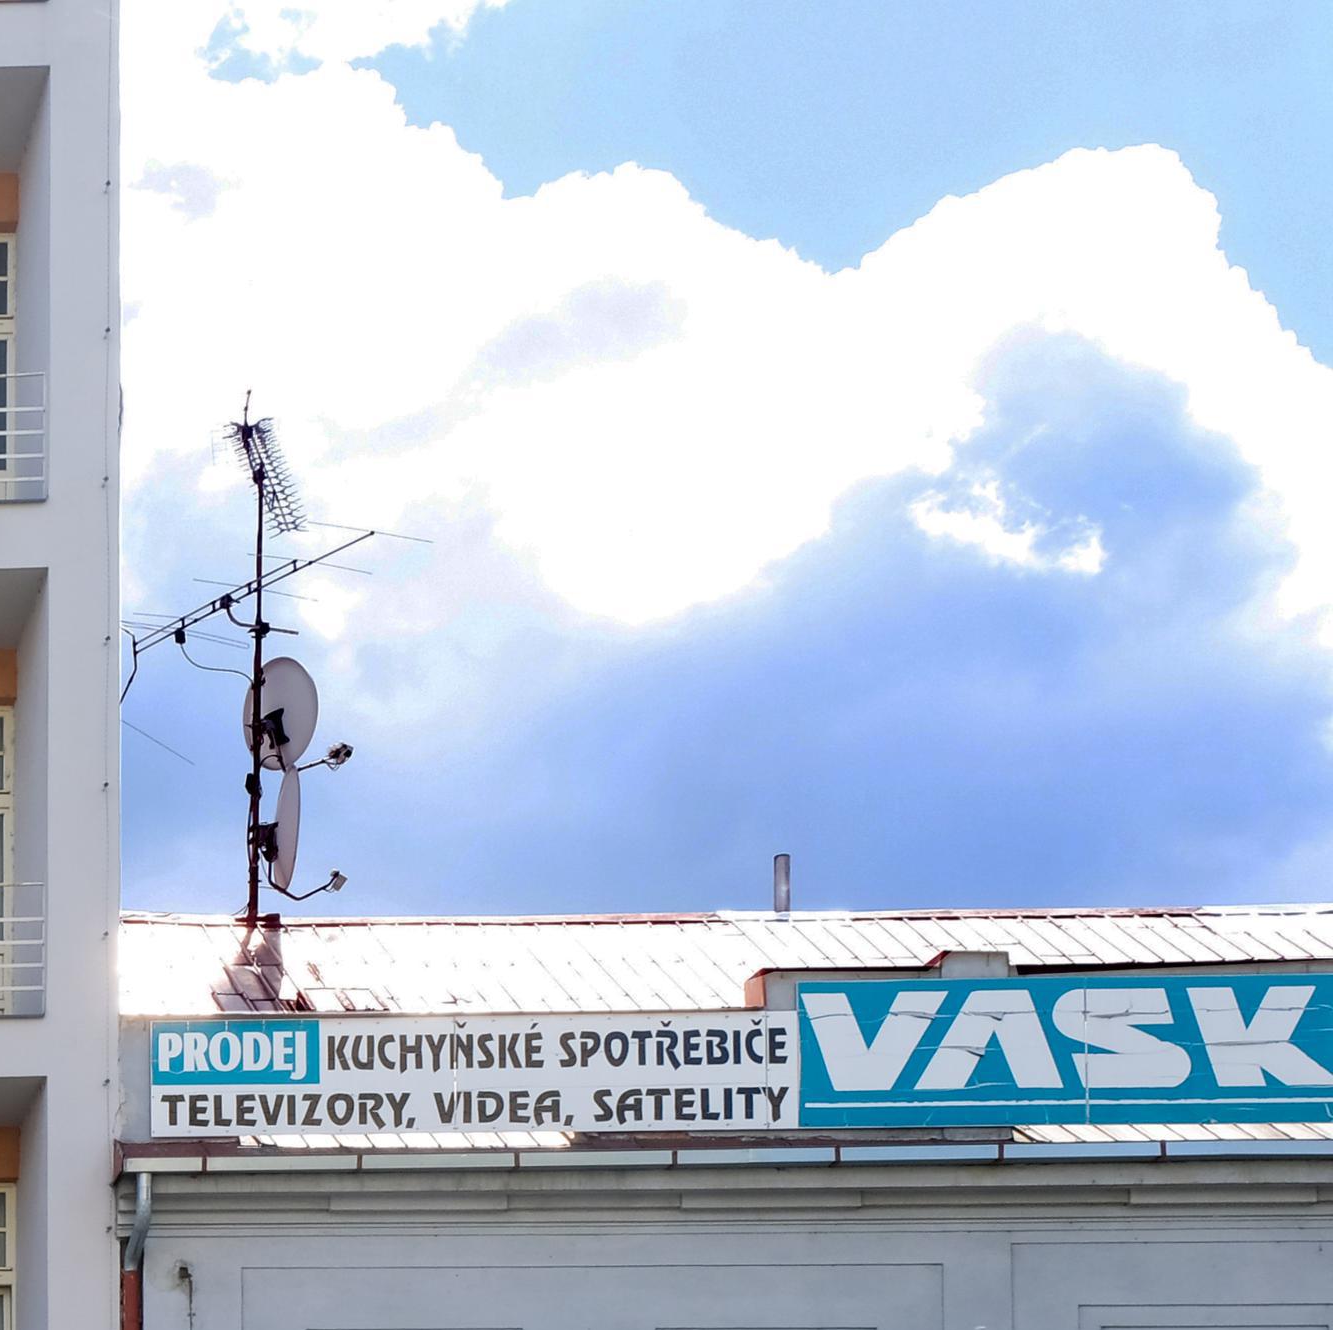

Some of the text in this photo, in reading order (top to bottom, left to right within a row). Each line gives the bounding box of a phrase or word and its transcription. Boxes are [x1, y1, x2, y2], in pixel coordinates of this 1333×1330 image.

[157, 1018, 789, 1083] PRODEJ KUCHYŇSKÉ SPOTŘEBIČE
[801, 984, 1333, 1092] VASK
[160, 1086, 790, 1130] TELEVIZORY, VIDEA, SATELITY
